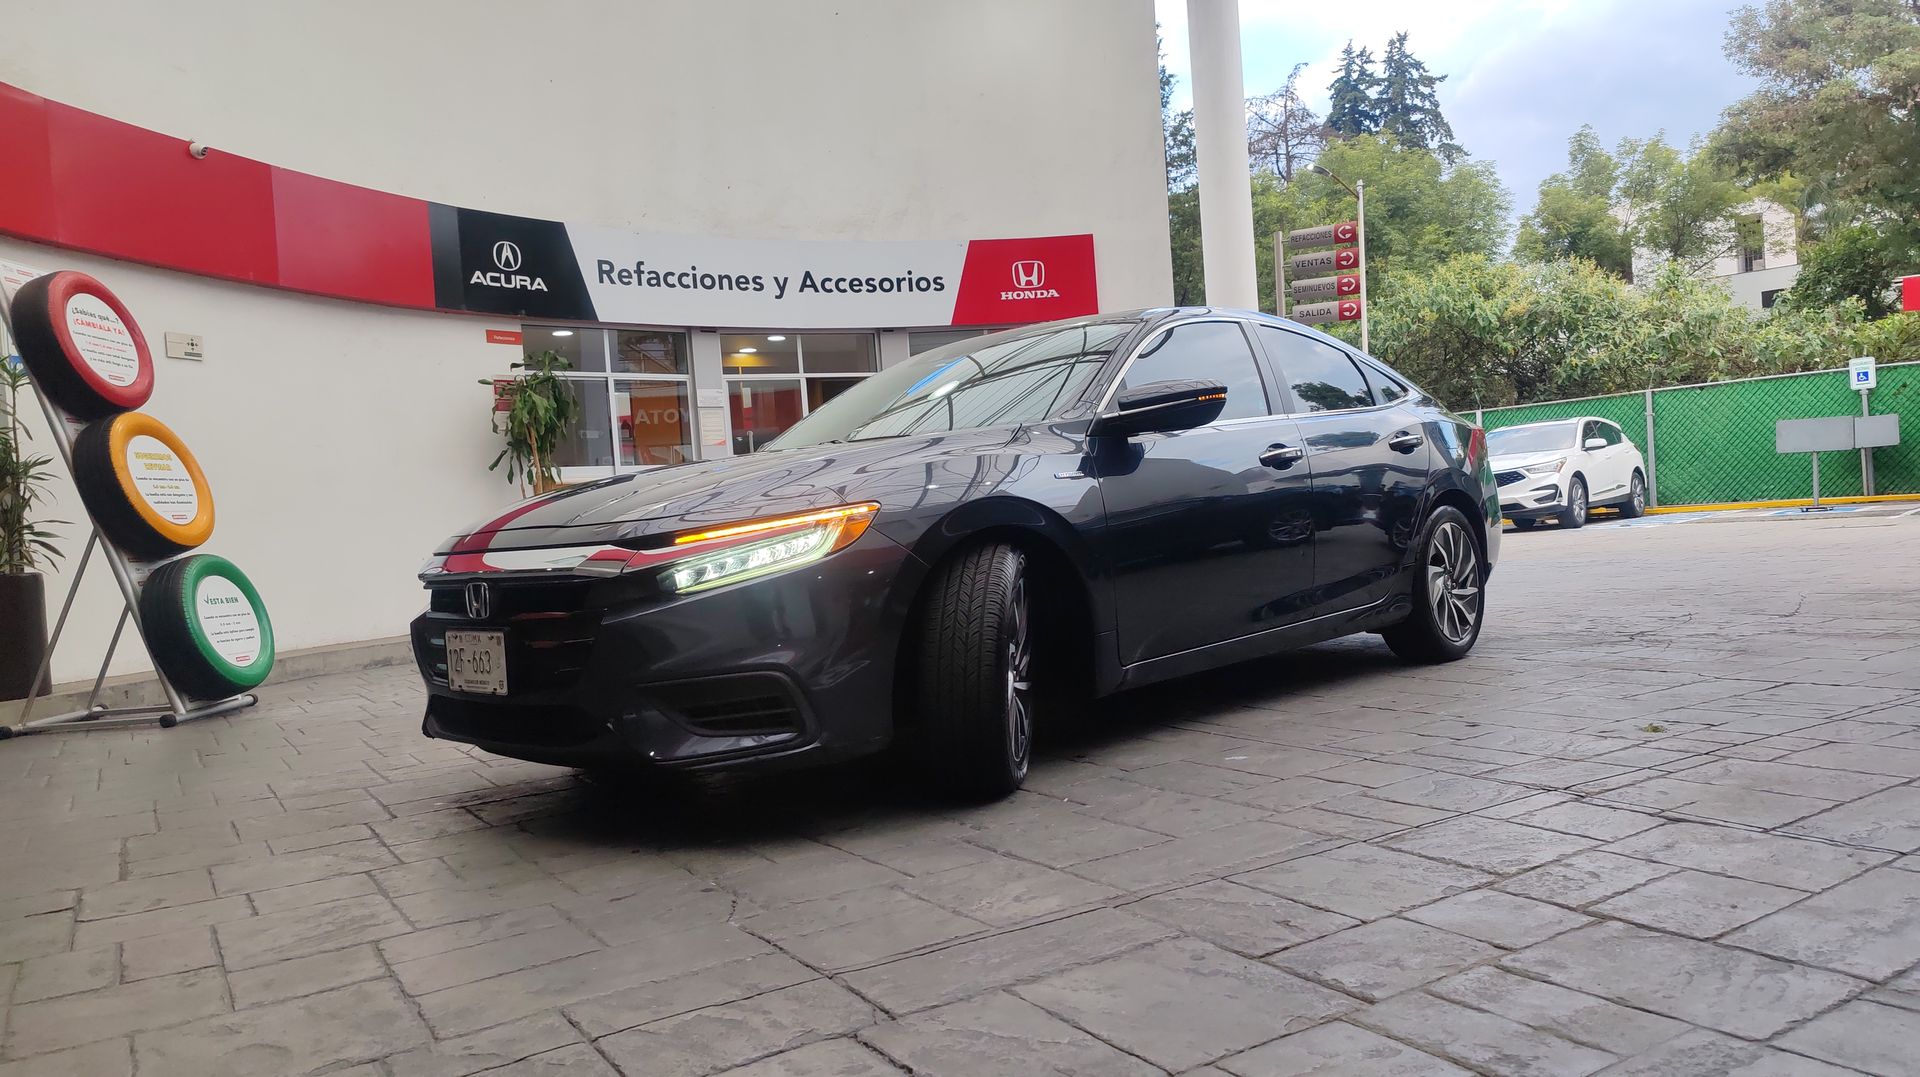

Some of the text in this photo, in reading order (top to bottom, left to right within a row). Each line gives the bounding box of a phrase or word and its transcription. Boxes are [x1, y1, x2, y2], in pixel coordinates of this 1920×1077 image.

[1290, 230, 1332, 242] REFACCIONES
[1295, 257, 1332, 268] VENTAS
[470, 270, 548, 292] ACURA
[597, 259, 945, 300] Refacciones y Accesorios
[1293, 282, 1335, 293] SEMINUEVOS
[1000, 289, 1060, 301] HONDA
[1299, 308, 1332, 318] SALIDA
[449, 647, 491, 673] 12F-663
